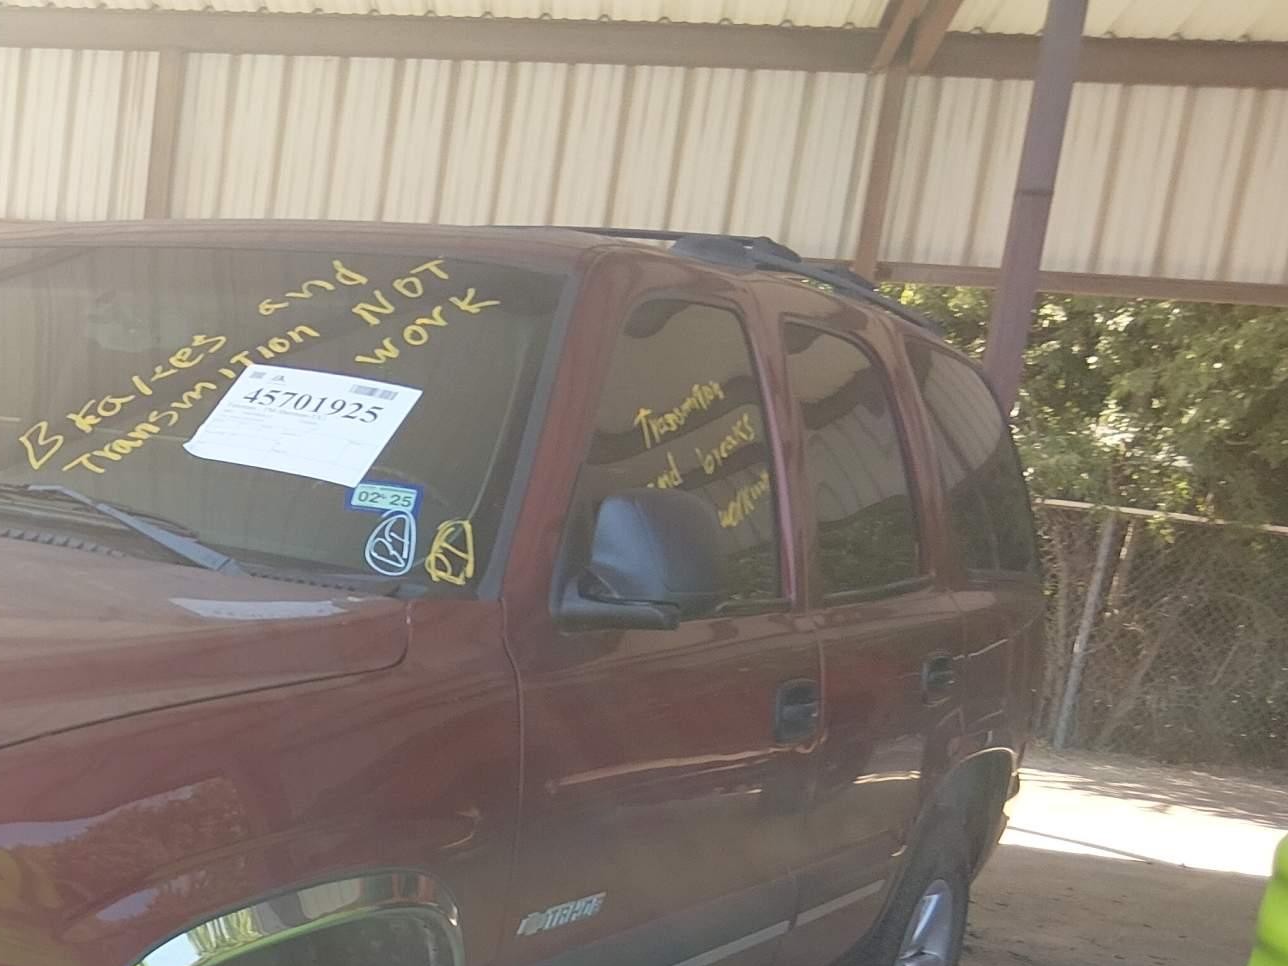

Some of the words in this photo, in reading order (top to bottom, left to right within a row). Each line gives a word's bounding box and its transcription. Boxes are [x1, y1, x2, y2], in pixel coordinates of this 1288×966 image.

[258, 259, 368, 316] and
[351, 258, 449, 326] NOT
[243, 387, 385, 424] 45701925
